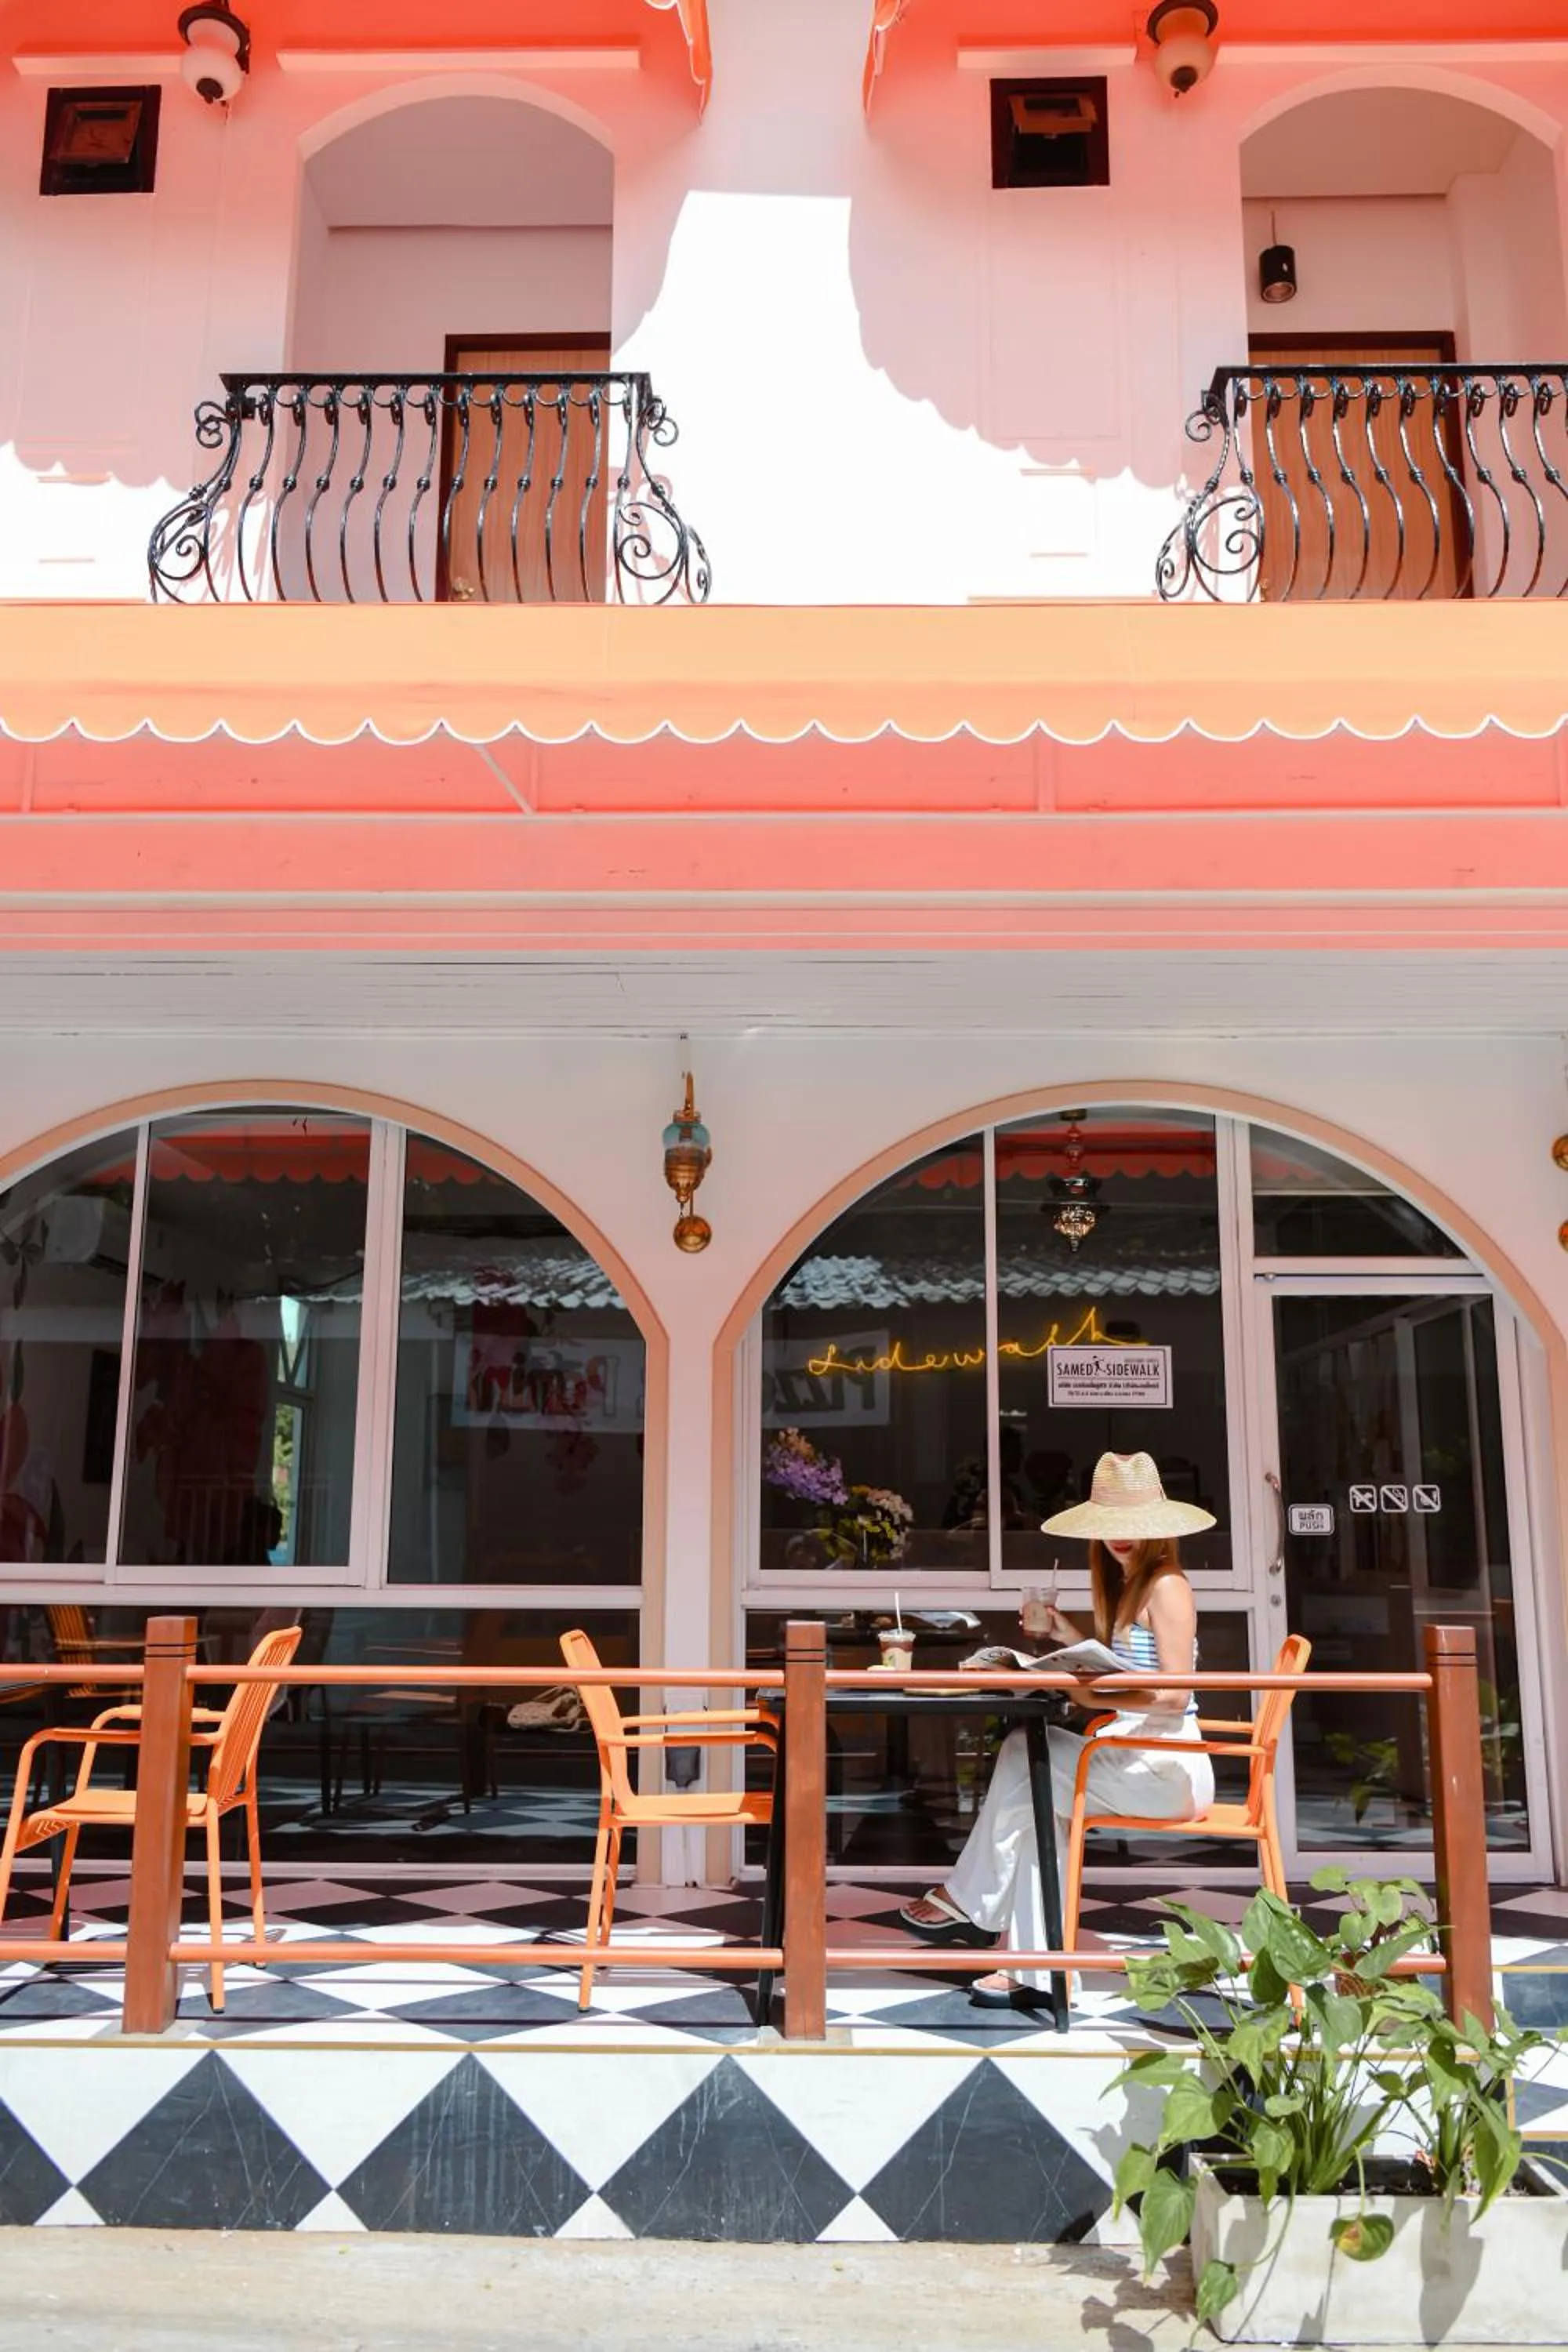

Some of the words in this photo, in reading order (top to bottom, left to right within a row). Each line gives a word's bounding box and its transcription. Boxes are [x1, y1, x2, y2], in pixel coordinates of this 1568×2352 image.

[1057, 1363, 1093, 1376] SAMED
[1106, 1363, 1160, 1376] SIDEWALK
[1298, 1509, 1324, 1520] ผลัก
